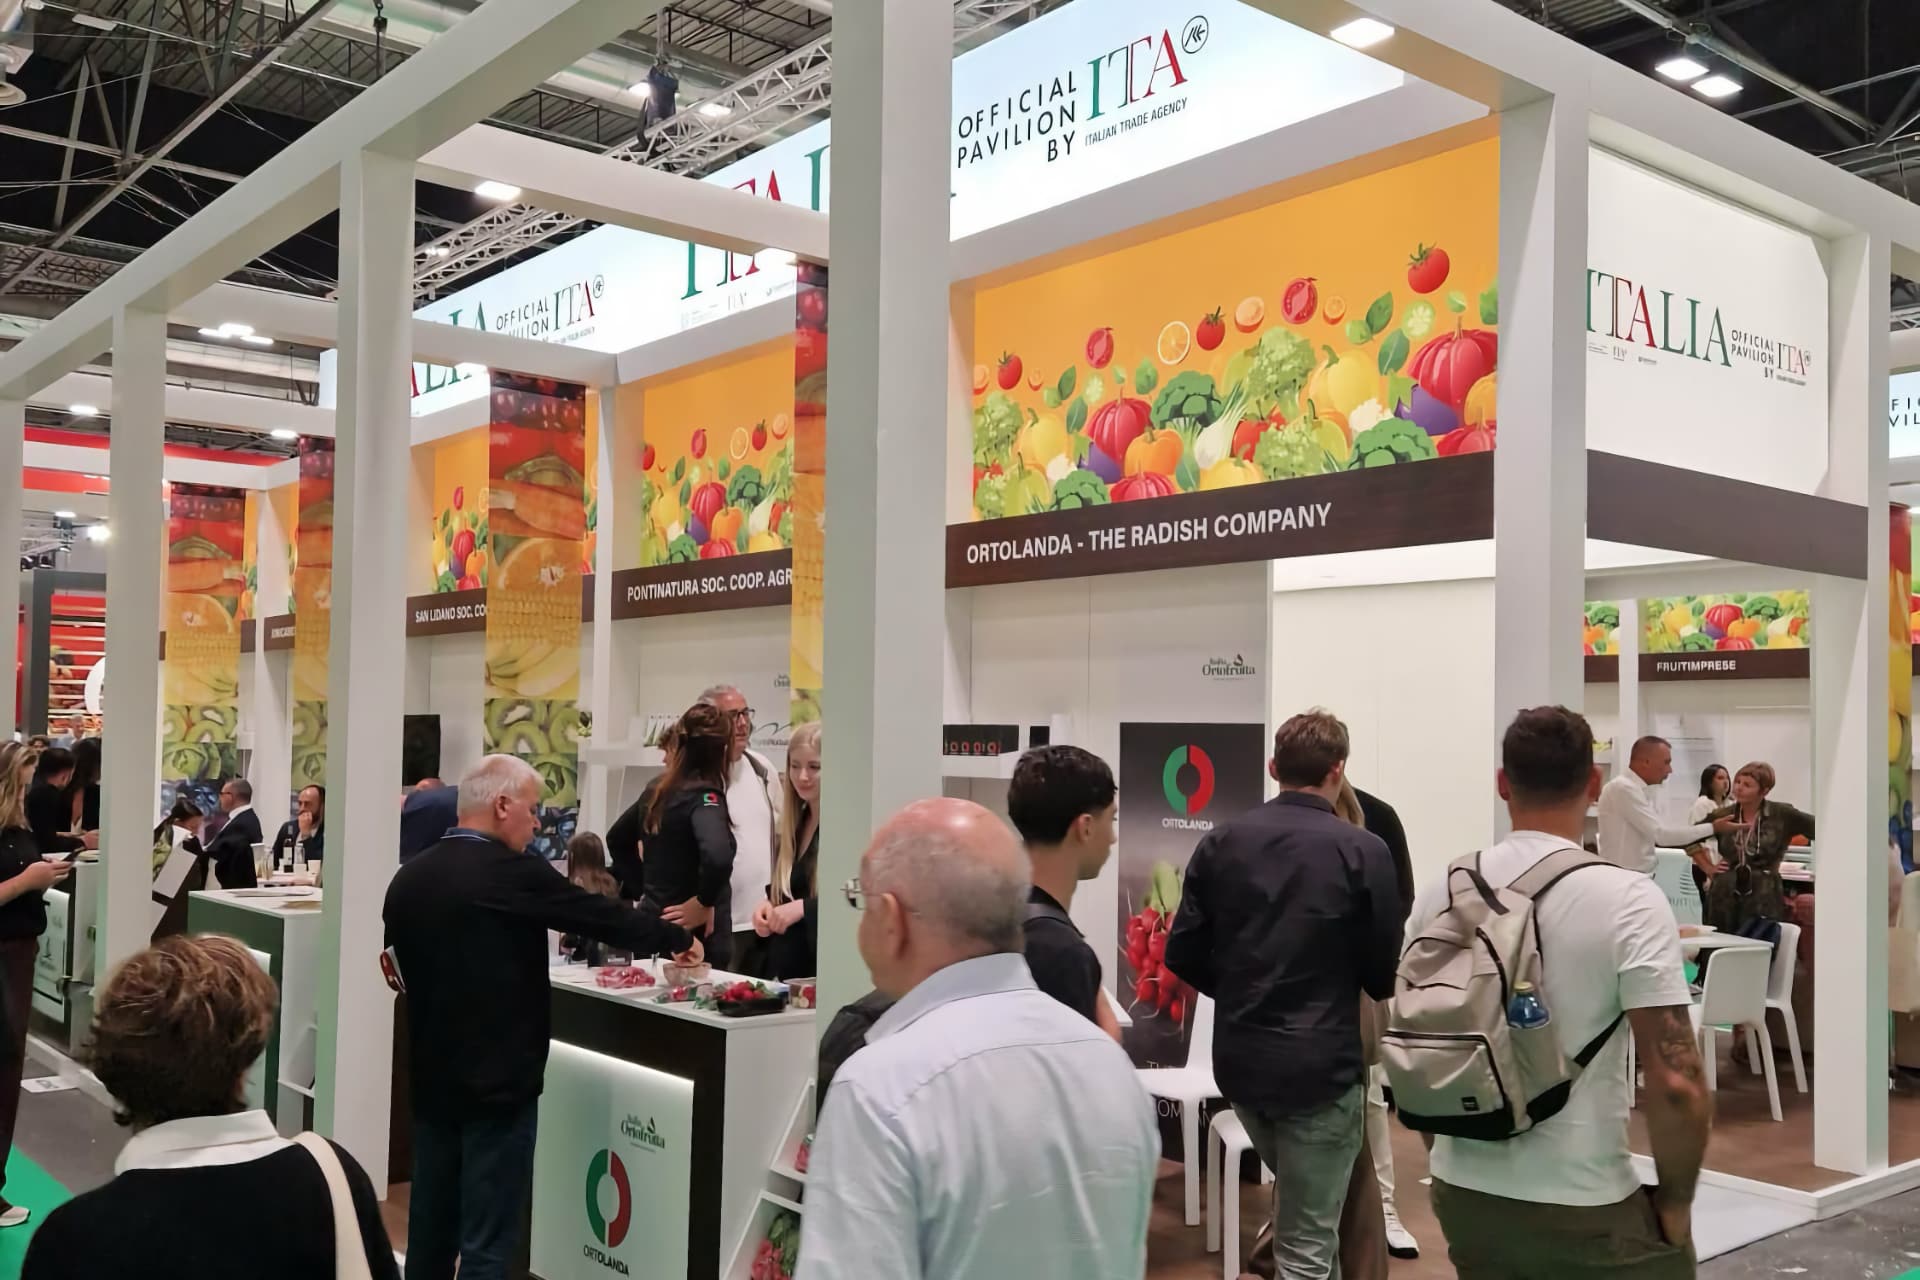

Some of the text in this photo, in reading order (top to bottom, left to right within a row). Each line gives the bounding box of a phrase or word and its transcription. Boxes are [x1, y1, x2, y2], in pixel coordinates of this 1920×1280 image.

[1086, 29, 1188, 121] ITA
[958, 71, 1077, 139] OFFICIAL
[1084, 97, 1188, 147] ITALIAN TRADE AGENCY
[957, 100, 1076, 169] PAVILION
[1047, 131, 1075, 162] BY
[496, 296, 550, 331] OFFICIAL
[553, 280, 595, 331] ITA
[1586, 269, 1732, 368] ITALIA
[1731, 329, 1774, 353] OFFICIAL
[1731, 343, 1774, 366] PAVILION
[1888, 412, 1920, 428] VIL
[966, 533, 1073, 564] ORTOLANDA
[1088, 526, 1126, 552] THE
[1130, 517, 1207, 547] RADISH
[1214, 501, 1332, 539] COMPANY
[627, 567, 793, 602] PONTINATURA SOC. COOP. AGR
[415, 603, 487, 623] SAN LIDANO SOC. CO
[1656, 659, 1737, 673] FRUITIMPRESE
[1161, 817, 1215, 831] ORTOLANDA
[583, 1244, 630, 1278] ORTOLANDA
